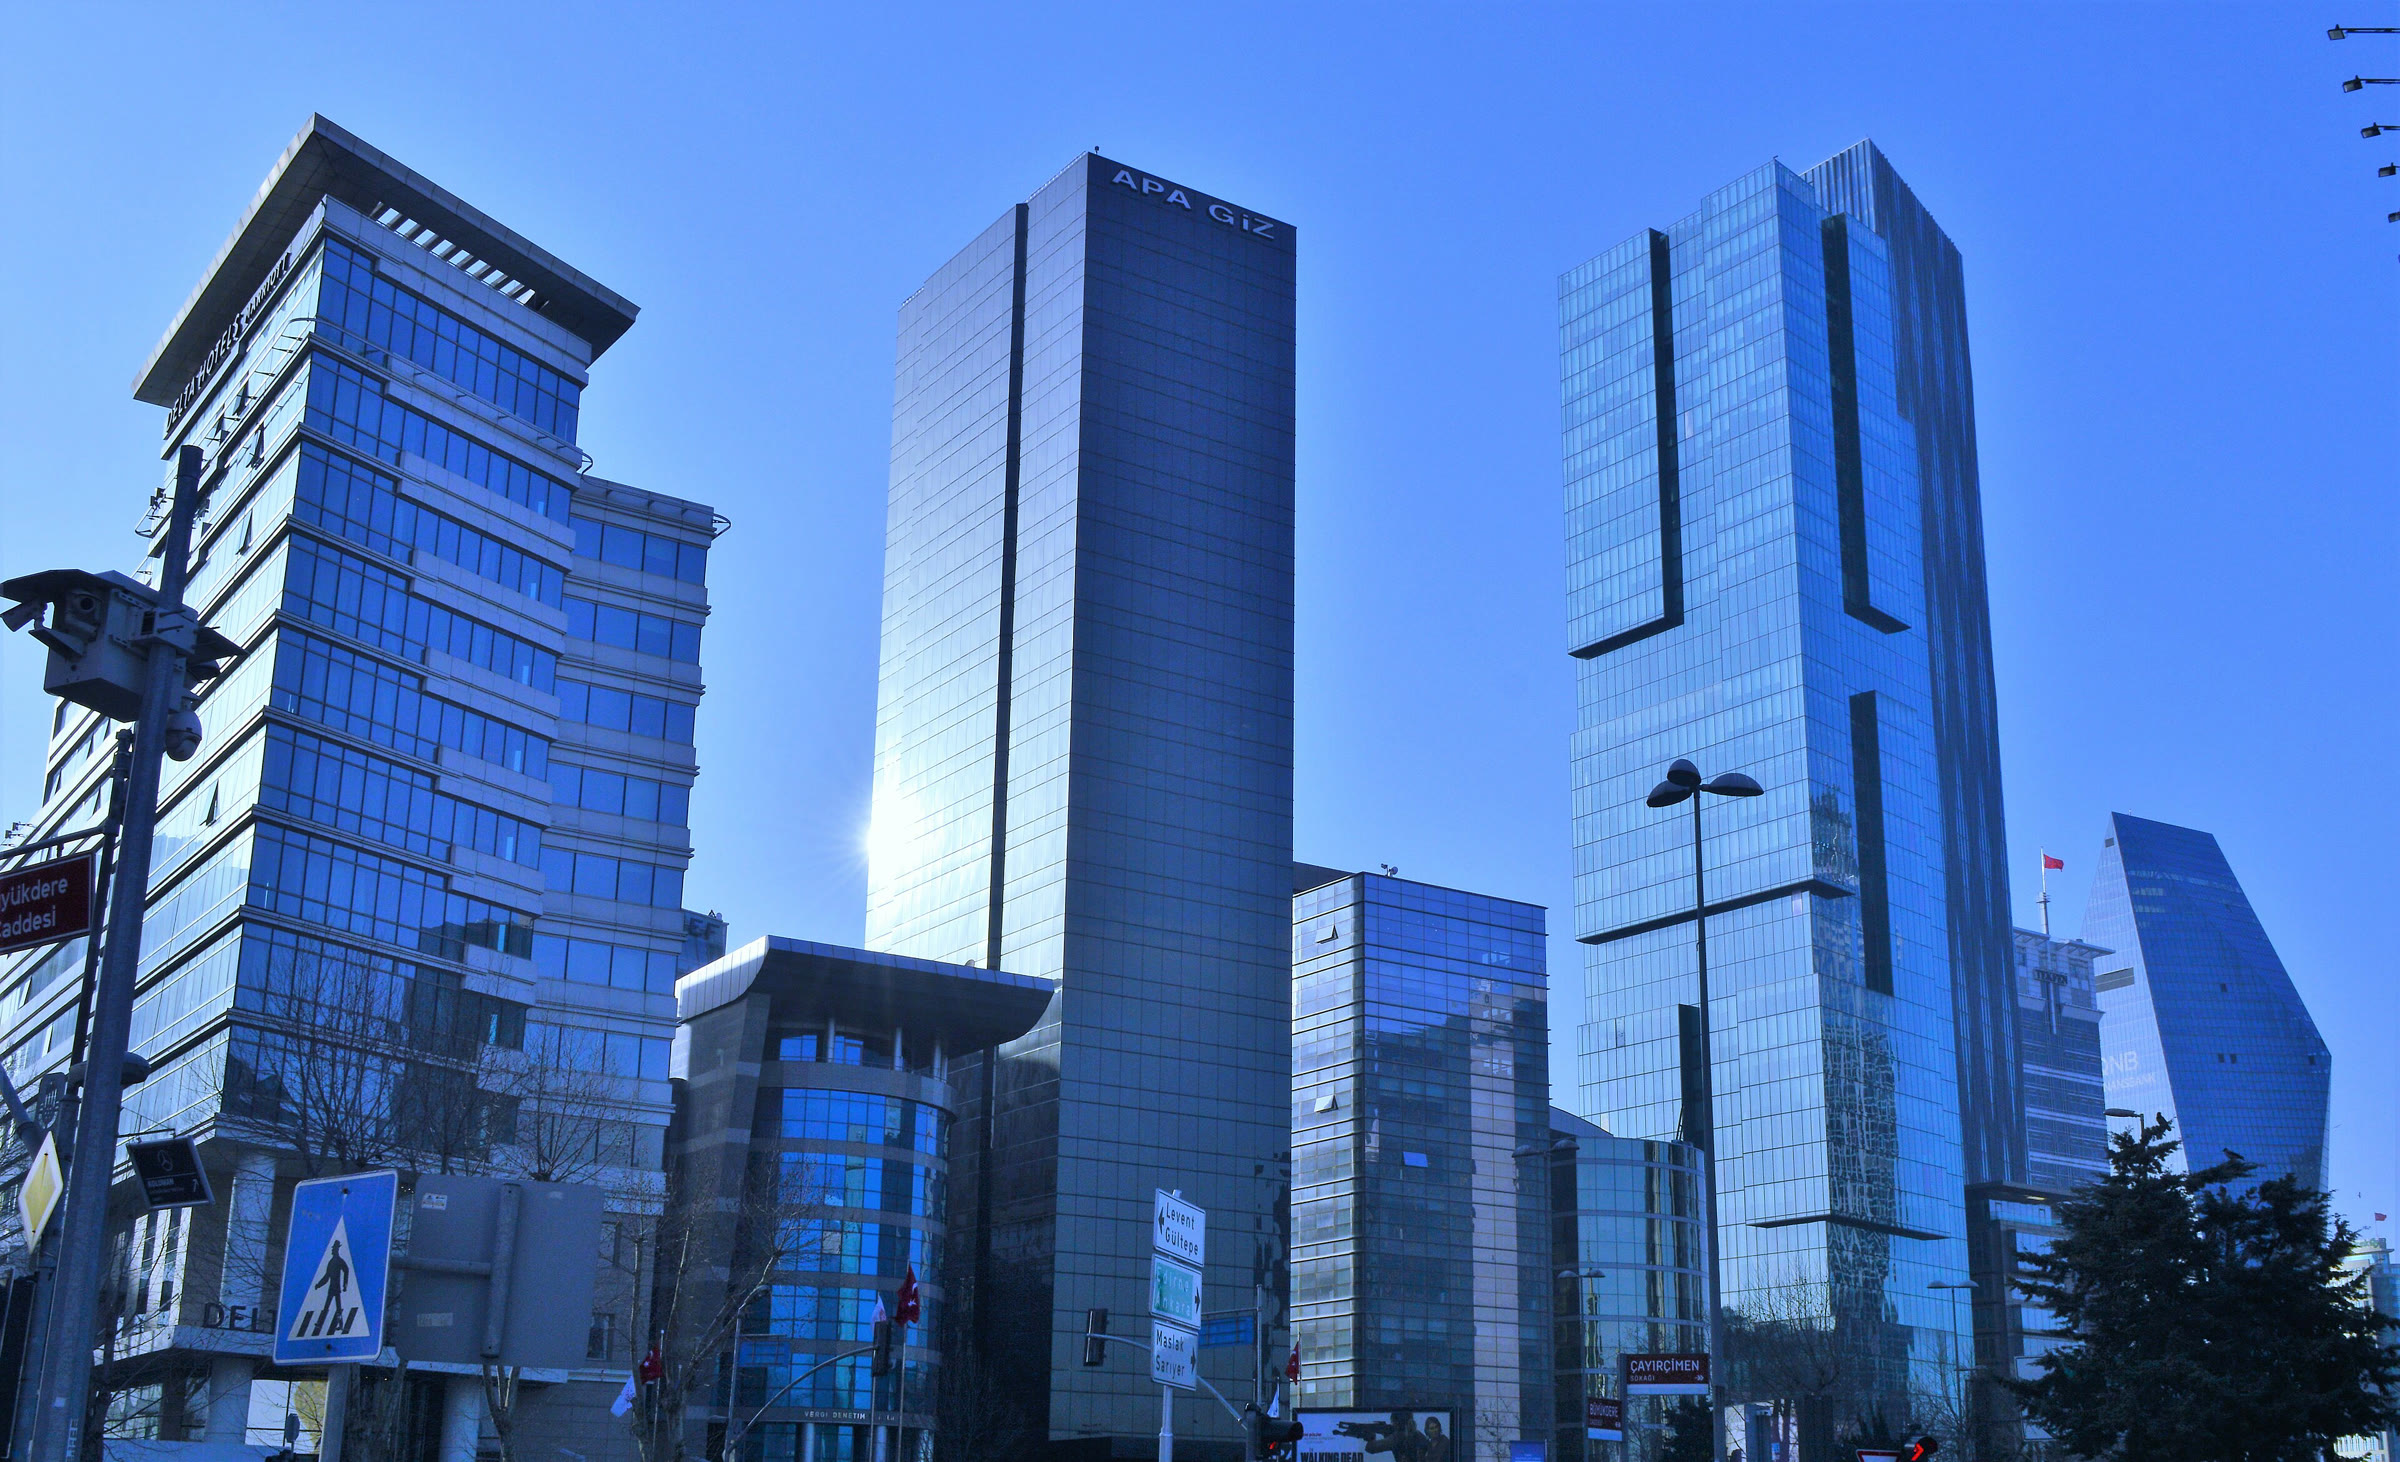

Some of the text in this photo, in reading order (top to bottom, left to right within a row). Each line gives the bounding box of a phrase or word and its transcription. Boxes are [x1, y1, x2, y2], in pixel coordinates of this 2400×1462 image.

[1112, 169, 1192, 210] APA
[166, 377, 199, 431] DELTA
[198, 312, 243, 389] HOTELS
[1165, 1202, 1195, 1231] Levent
[1165, 1227, 1199, 1257] Gültepe
[1156, 1329, 1184, 1353] Maslak
[1630, 1357, 1700, 1374] ÇAYIRÇİMEN
